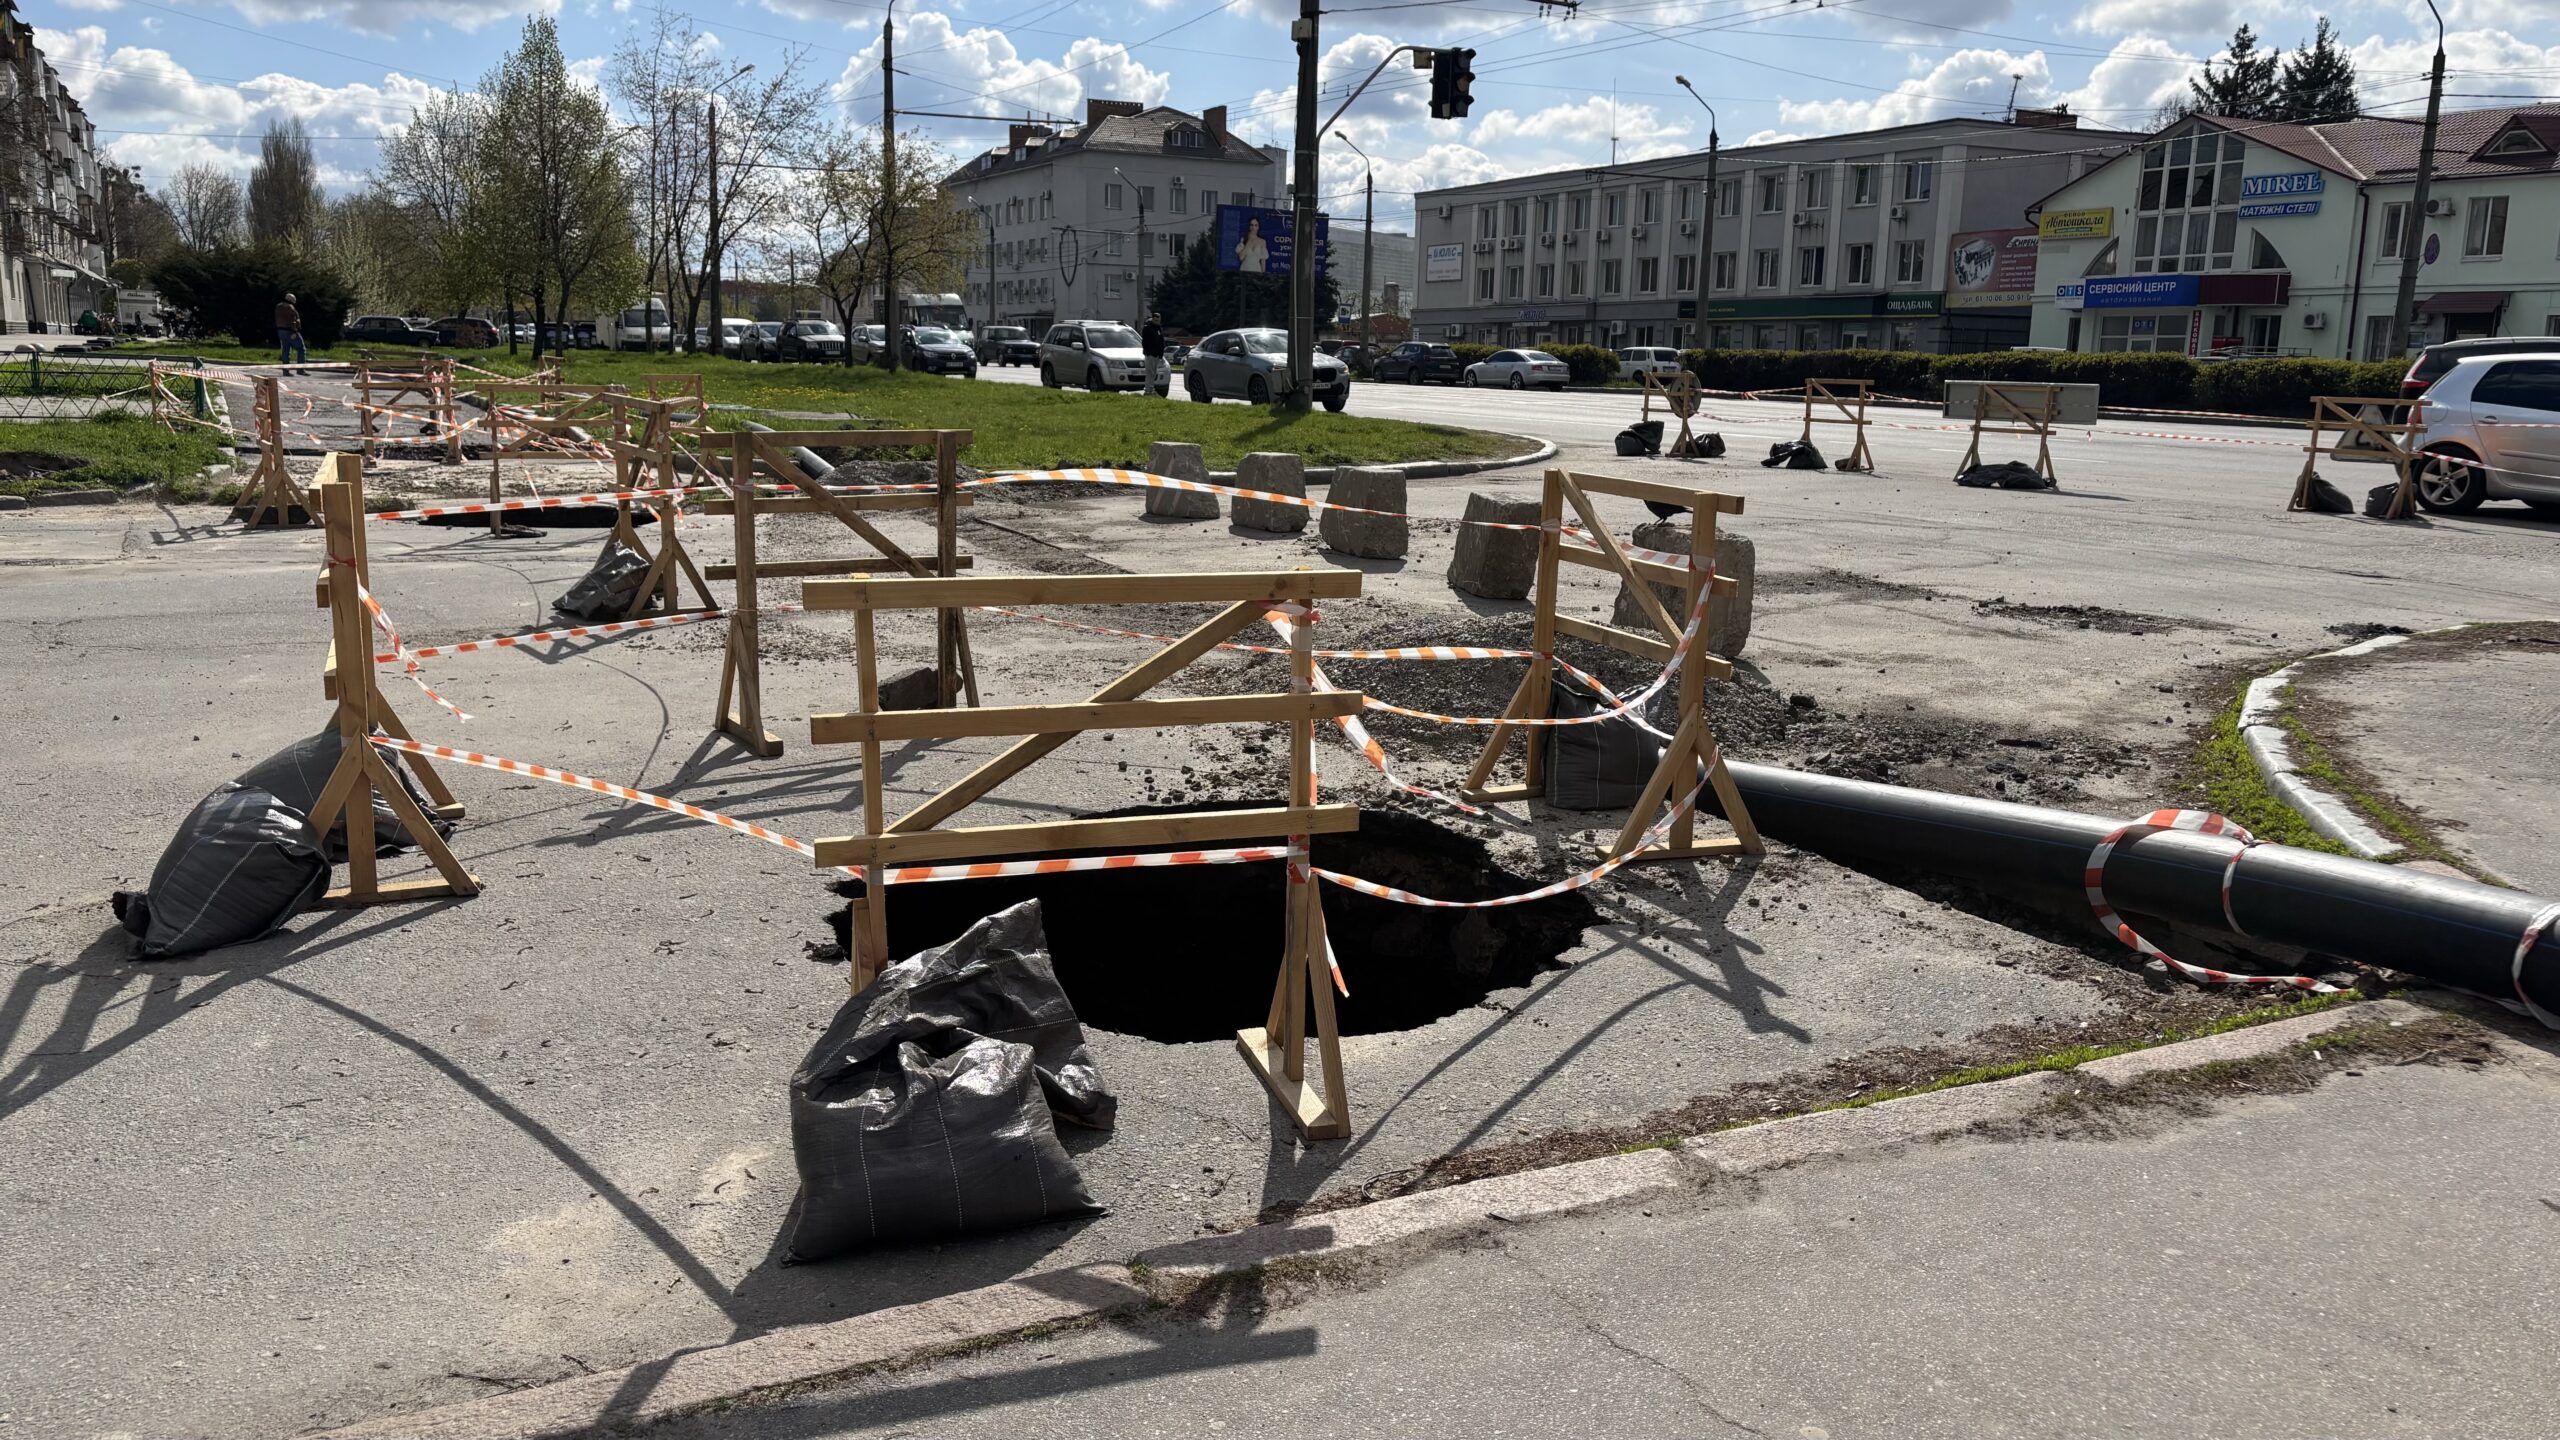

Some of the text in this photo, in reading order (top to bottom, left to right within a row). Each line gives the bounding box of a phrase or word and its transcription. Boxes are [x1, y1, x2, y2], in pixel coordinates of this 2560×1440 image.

[2244, 174, 2319, 195] MIREL
[2240, 203, 2315, 216] НАТЯЖНІ СТЕЛІ
[2057, 286, 2083, 296] OTS
[2089, 281, 2177, 294] СЕРВІСНИЙ ЦЕНТР
[1887, 301, 1933, 311] ОЩАДБАНК
